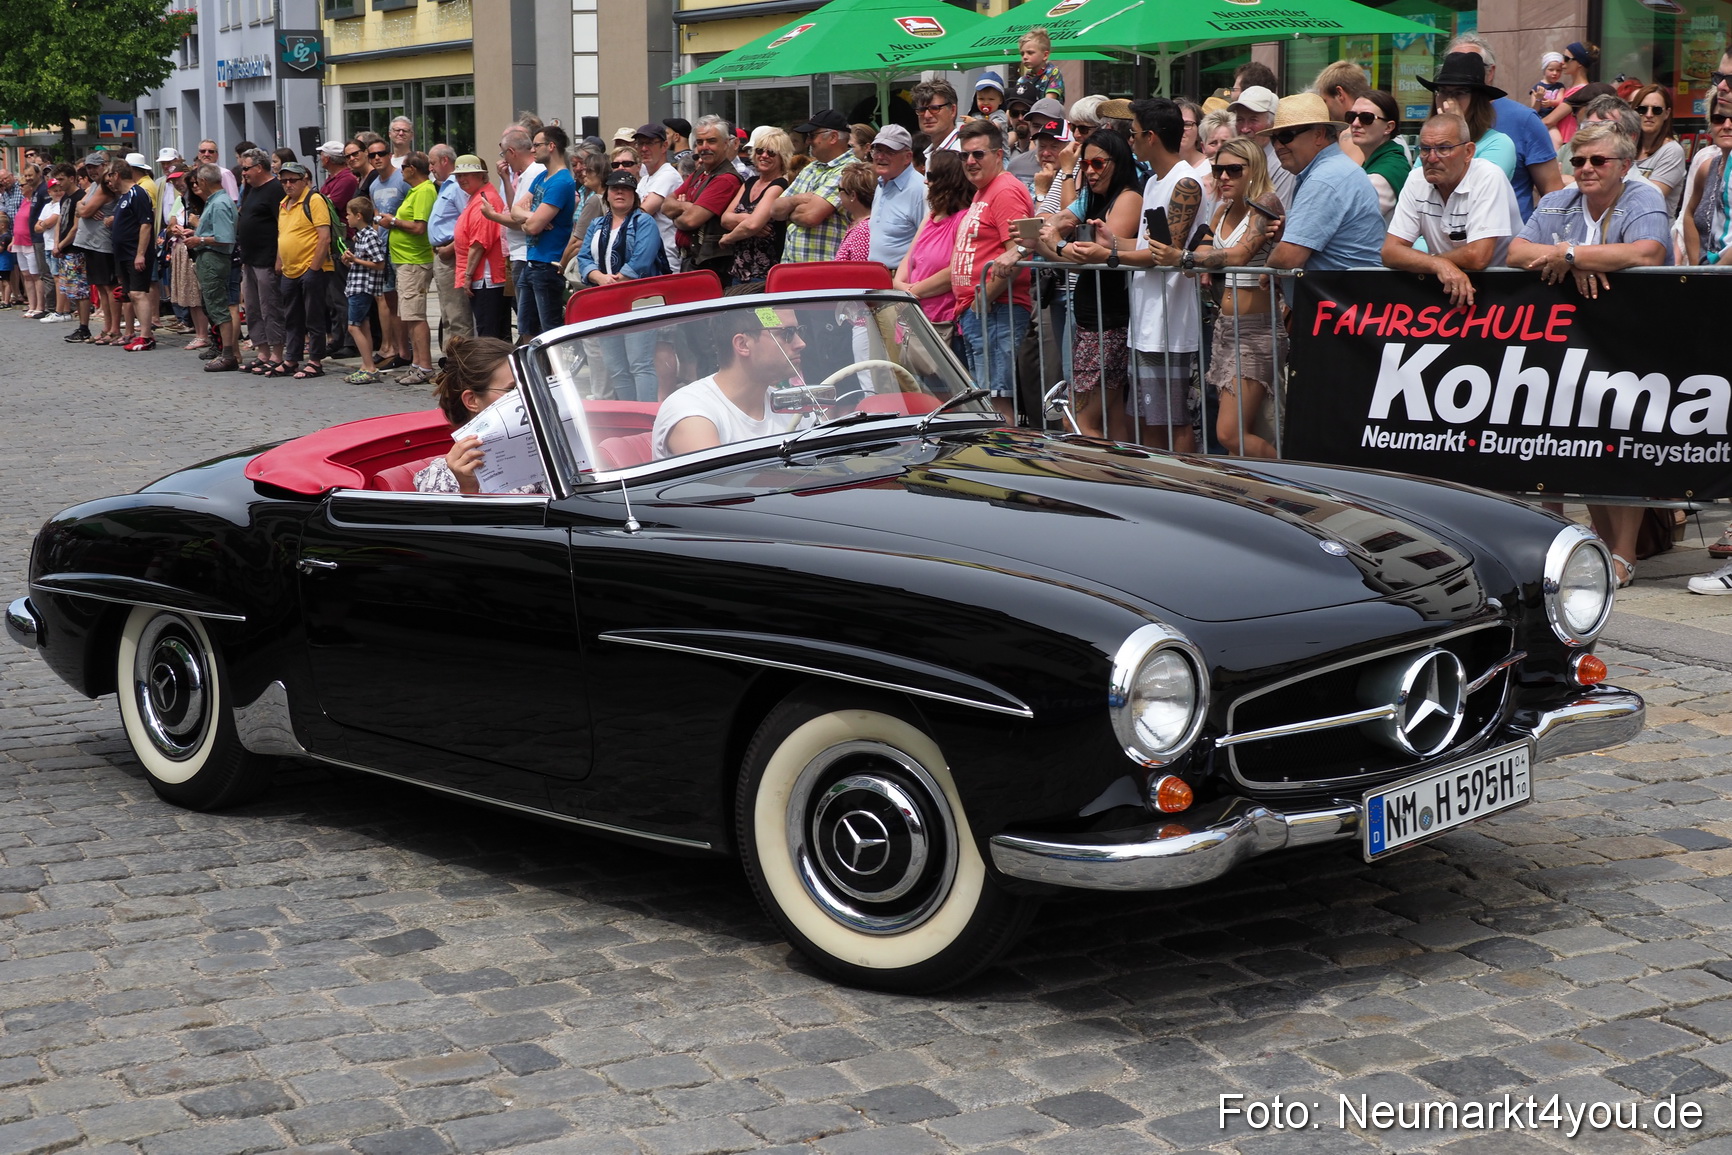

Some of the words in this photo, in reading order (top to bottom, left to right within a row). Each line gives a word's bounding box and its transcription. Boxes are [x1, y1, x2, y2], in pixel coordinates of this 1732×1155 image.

[1212, 8, 1310, 19] Neumarkter
[1206, 18, 1344, 31] Lammsbräu
[293, 43, 310, 62] G2
[1312, 300, 1577, 342] FAHRSCHULE
[1367, 342, 1732, 436] Kohlma
[1361, 425, 1466, 452] Neumarkt
[1480, 430, 1603, 461] Burgthann
[1618, 437, 1731, 467] Freystadt
[1515, 753, 1525, 767] 04
[1516, 781, 1527, 795] 10
[1386, 791, 1418, 842] NM
[1373, 831, 1380, 843] D
